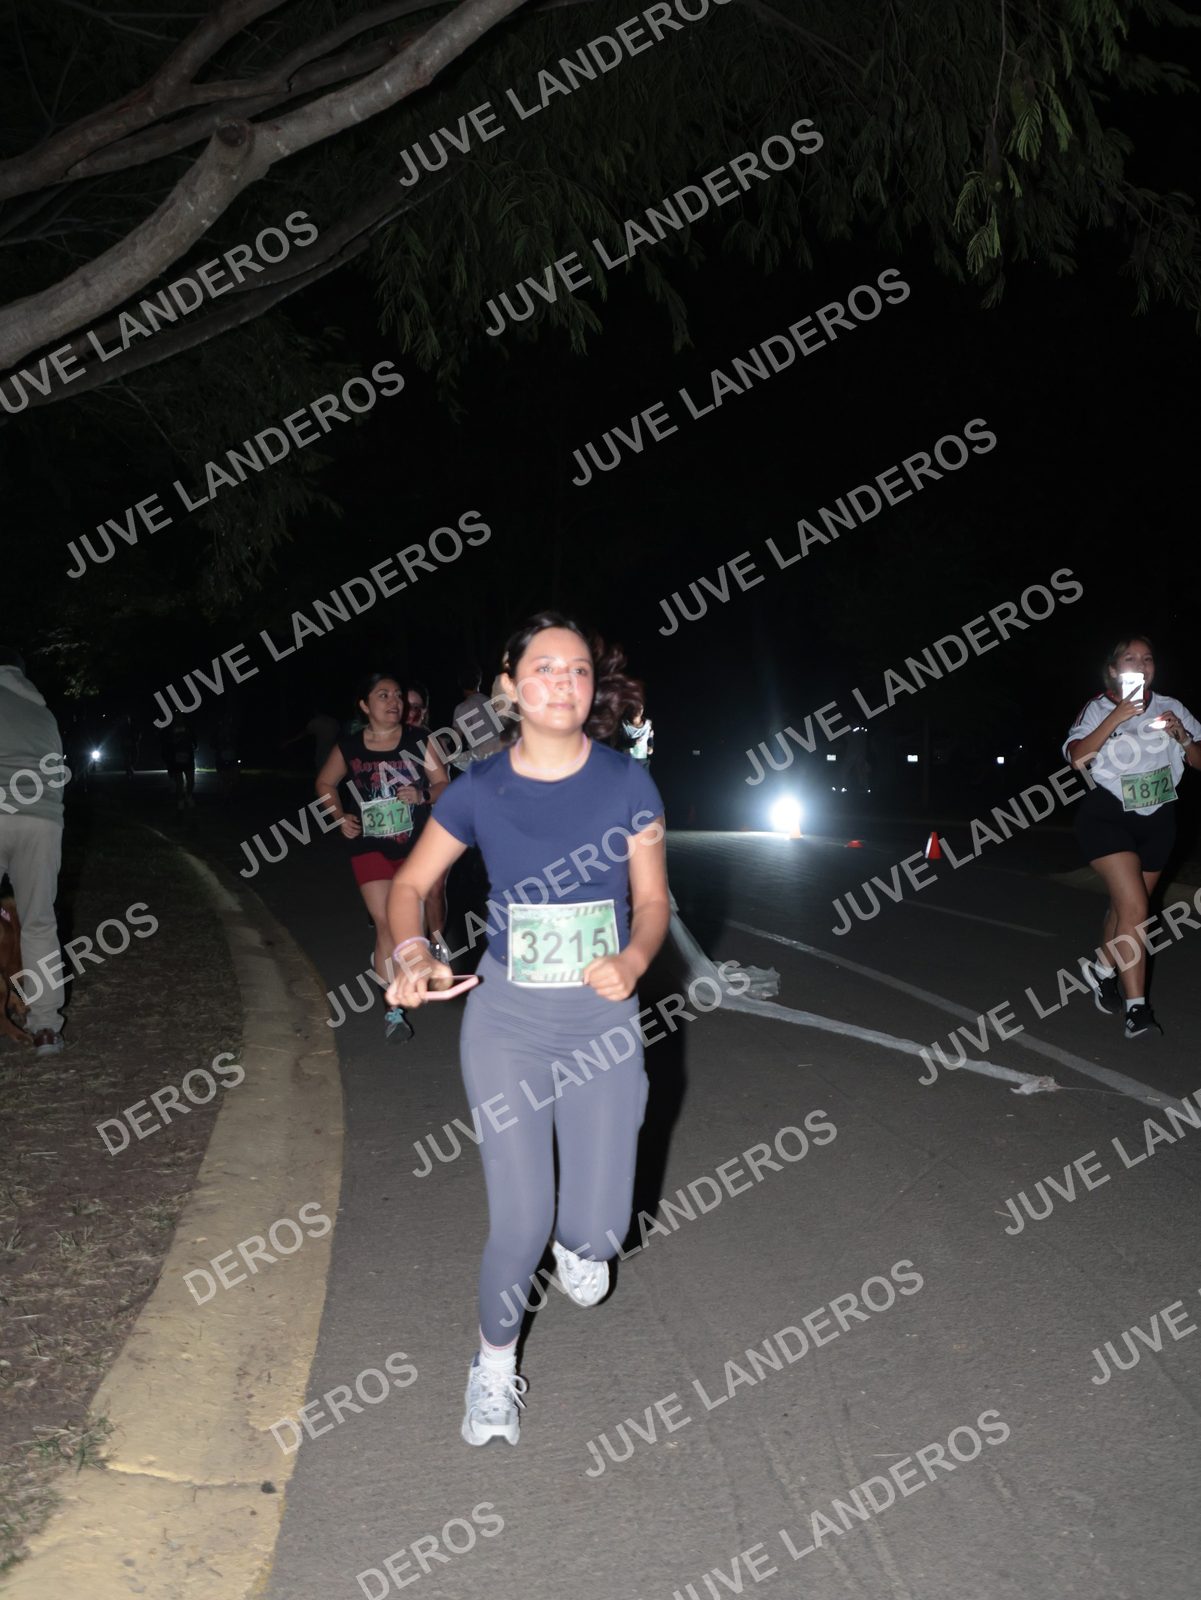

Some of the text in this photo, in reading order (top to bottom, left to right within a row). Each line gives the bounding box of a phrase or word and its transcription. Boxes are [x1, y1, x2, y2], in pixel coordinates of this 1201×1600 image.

[1128, 777, 1170, 800] 1872
[367, 808, 405, 828] 3217
[521, 927, 609, 964] 3215
